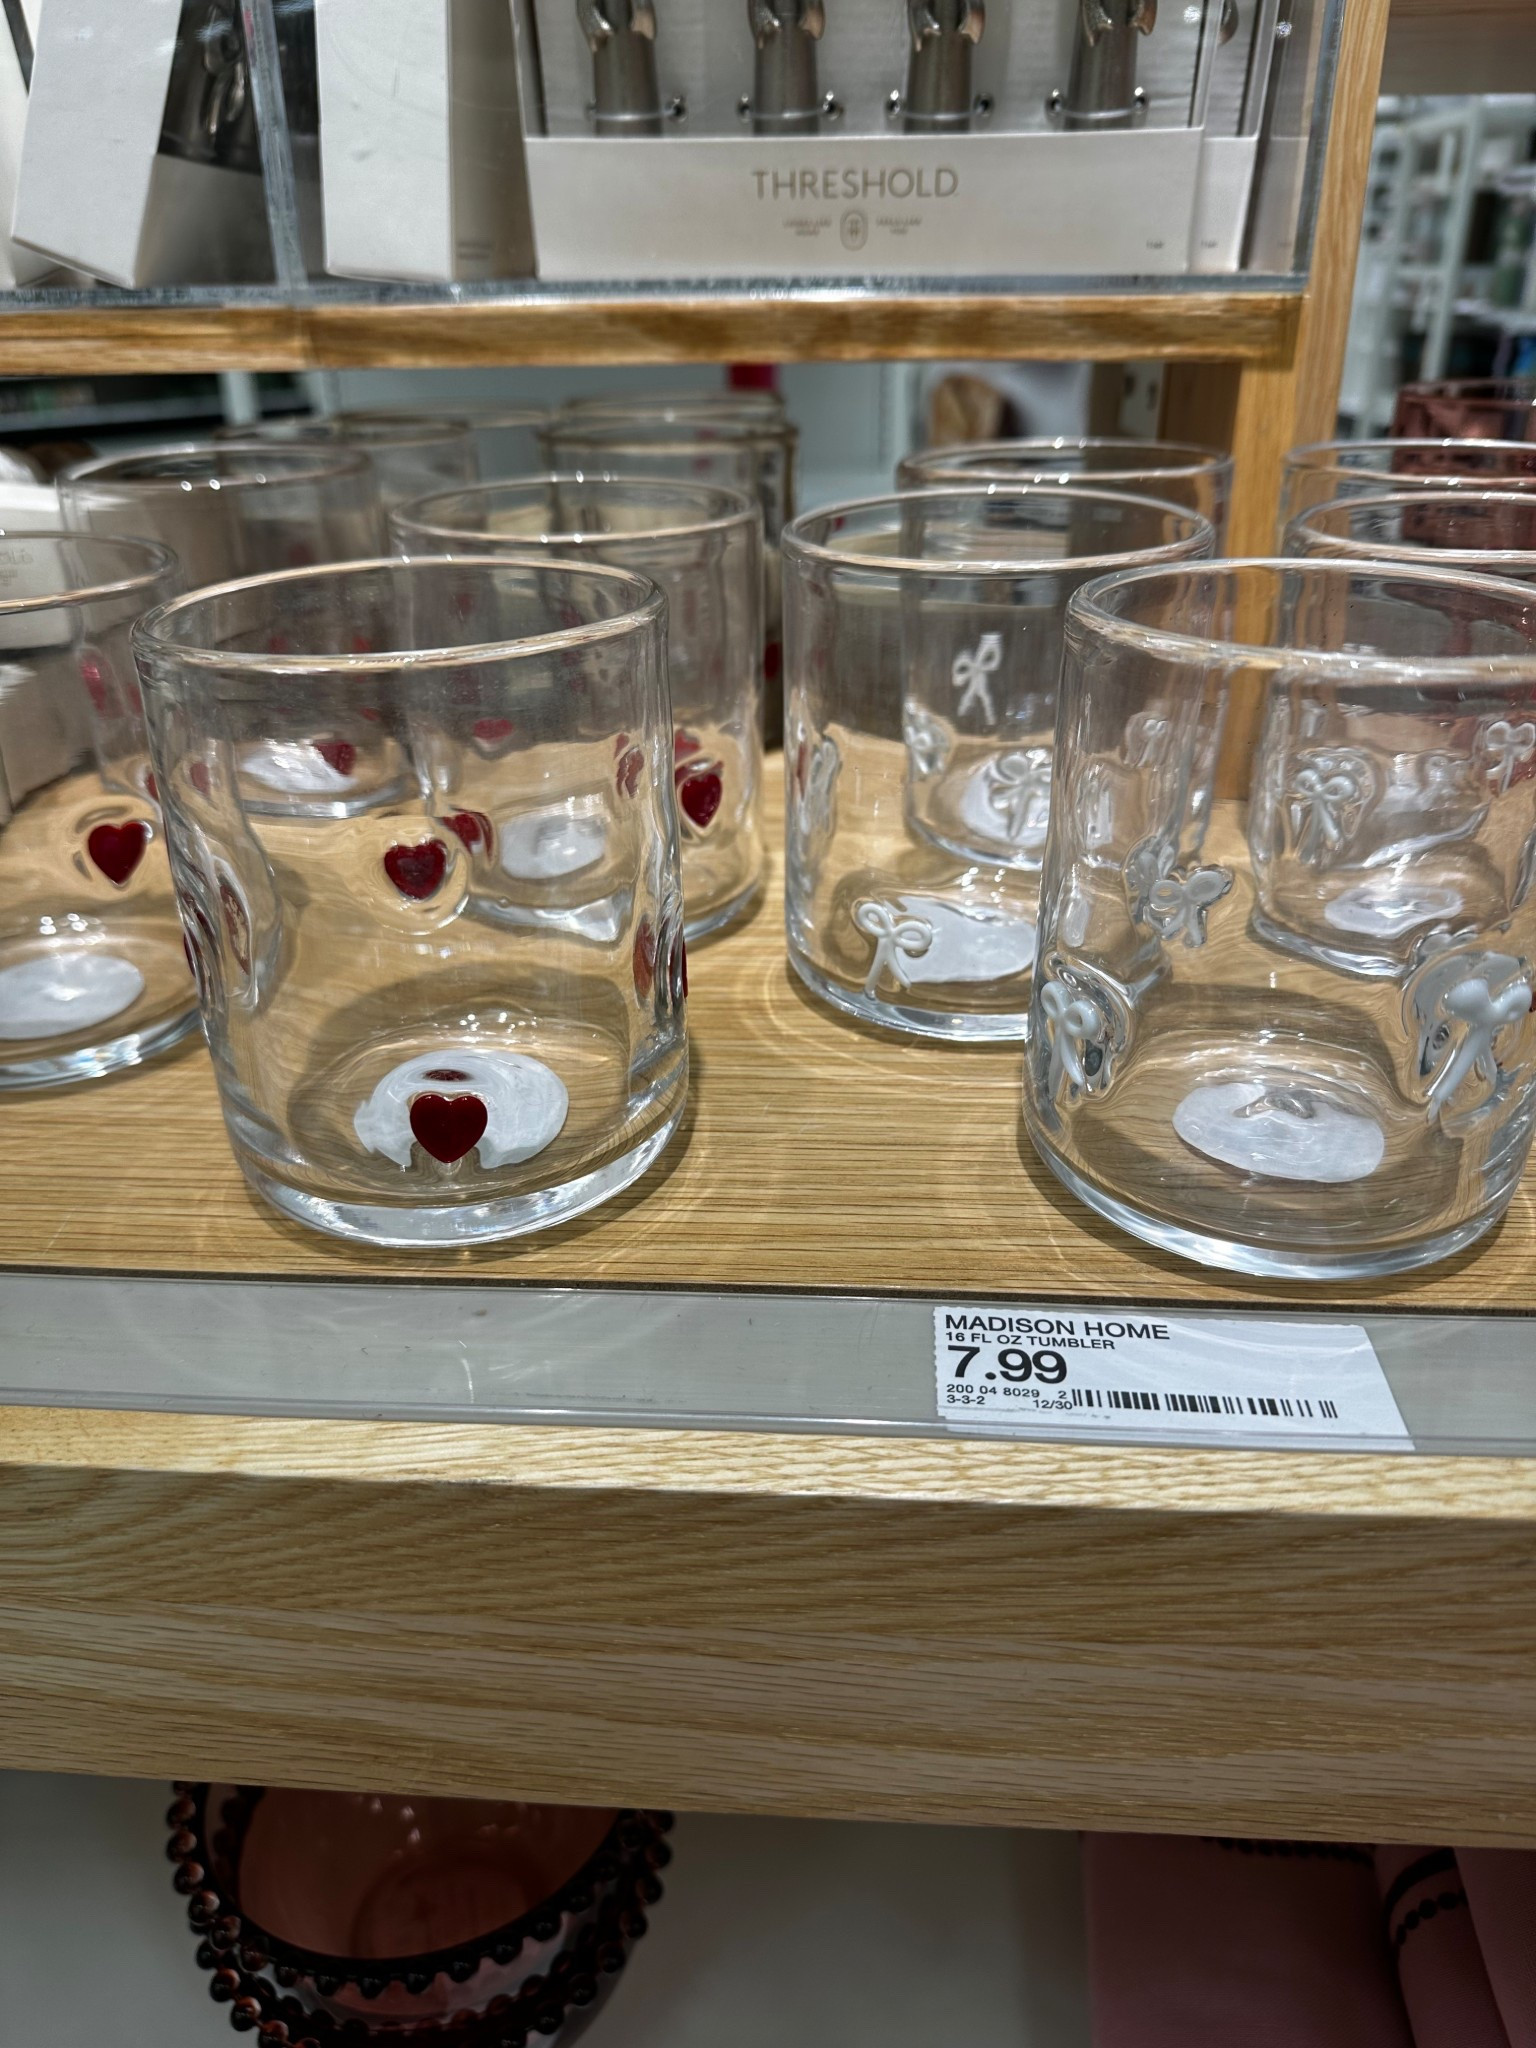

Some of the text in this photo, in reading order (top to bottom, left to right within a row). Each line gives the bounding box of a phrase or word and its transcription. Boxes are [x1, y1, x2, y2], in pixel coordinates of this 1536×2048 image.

[752, 168, 959, 200] THRESHOLD
[945, 1314, 1170, 1340] MADISON HOME
[946, 1332, 1115, 1350] 16 FL OZ TUMBLER
[947, 1345, 1068, 1384] 7.99
[946, 1384, 1067, 1399] 200 04 8029 2
[946, 1394, 1073, 1410] 3-3-2 12/30
